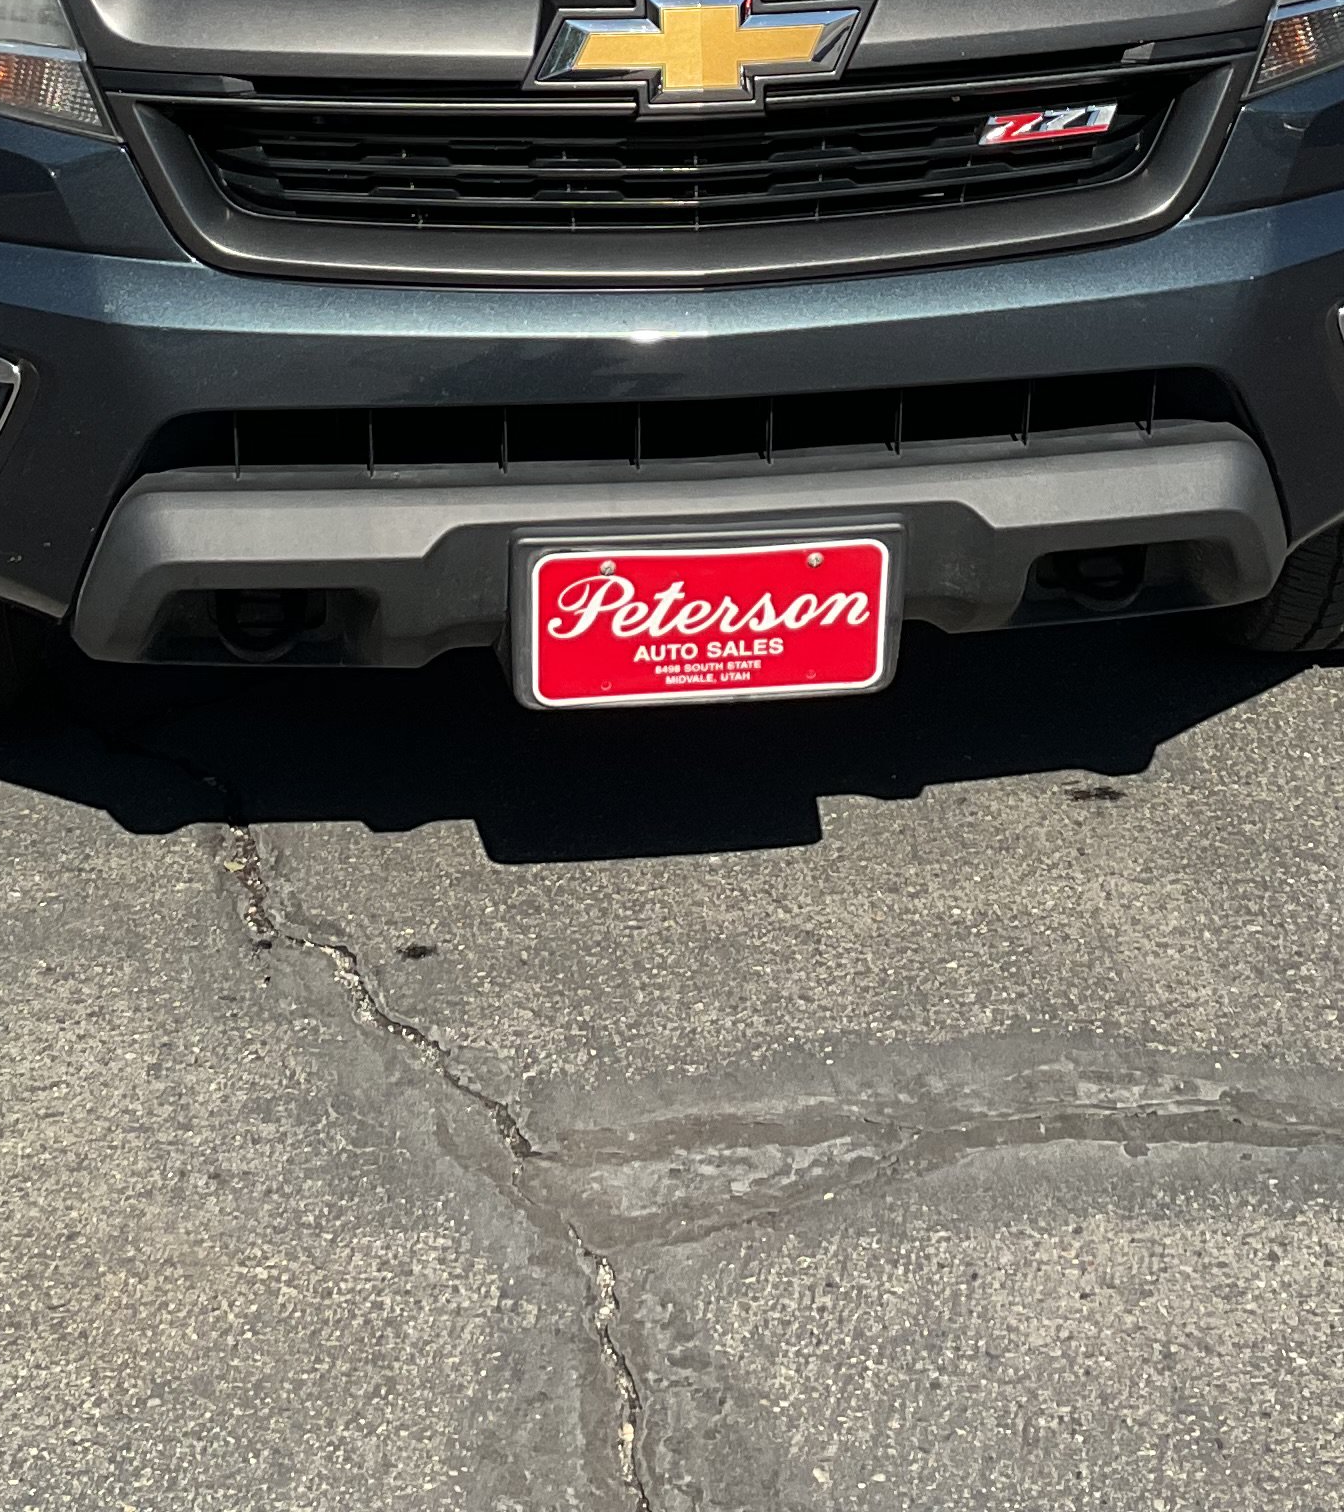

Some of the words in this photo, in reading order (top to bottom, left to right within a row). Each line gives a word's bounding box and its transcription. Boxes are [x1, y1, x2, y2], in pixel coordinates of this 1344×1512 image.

[979, 103, 1117, 145] Z71
[548, 574, 870, 638] Peterson
[633, 642, 699, 662] AUTO
[706, 637, 784, 658] SALES
[684, 662, 724, 672] SOUTH
[727, 659, 761, 670] STATE
[720, 671, 751, 681] UTAH
